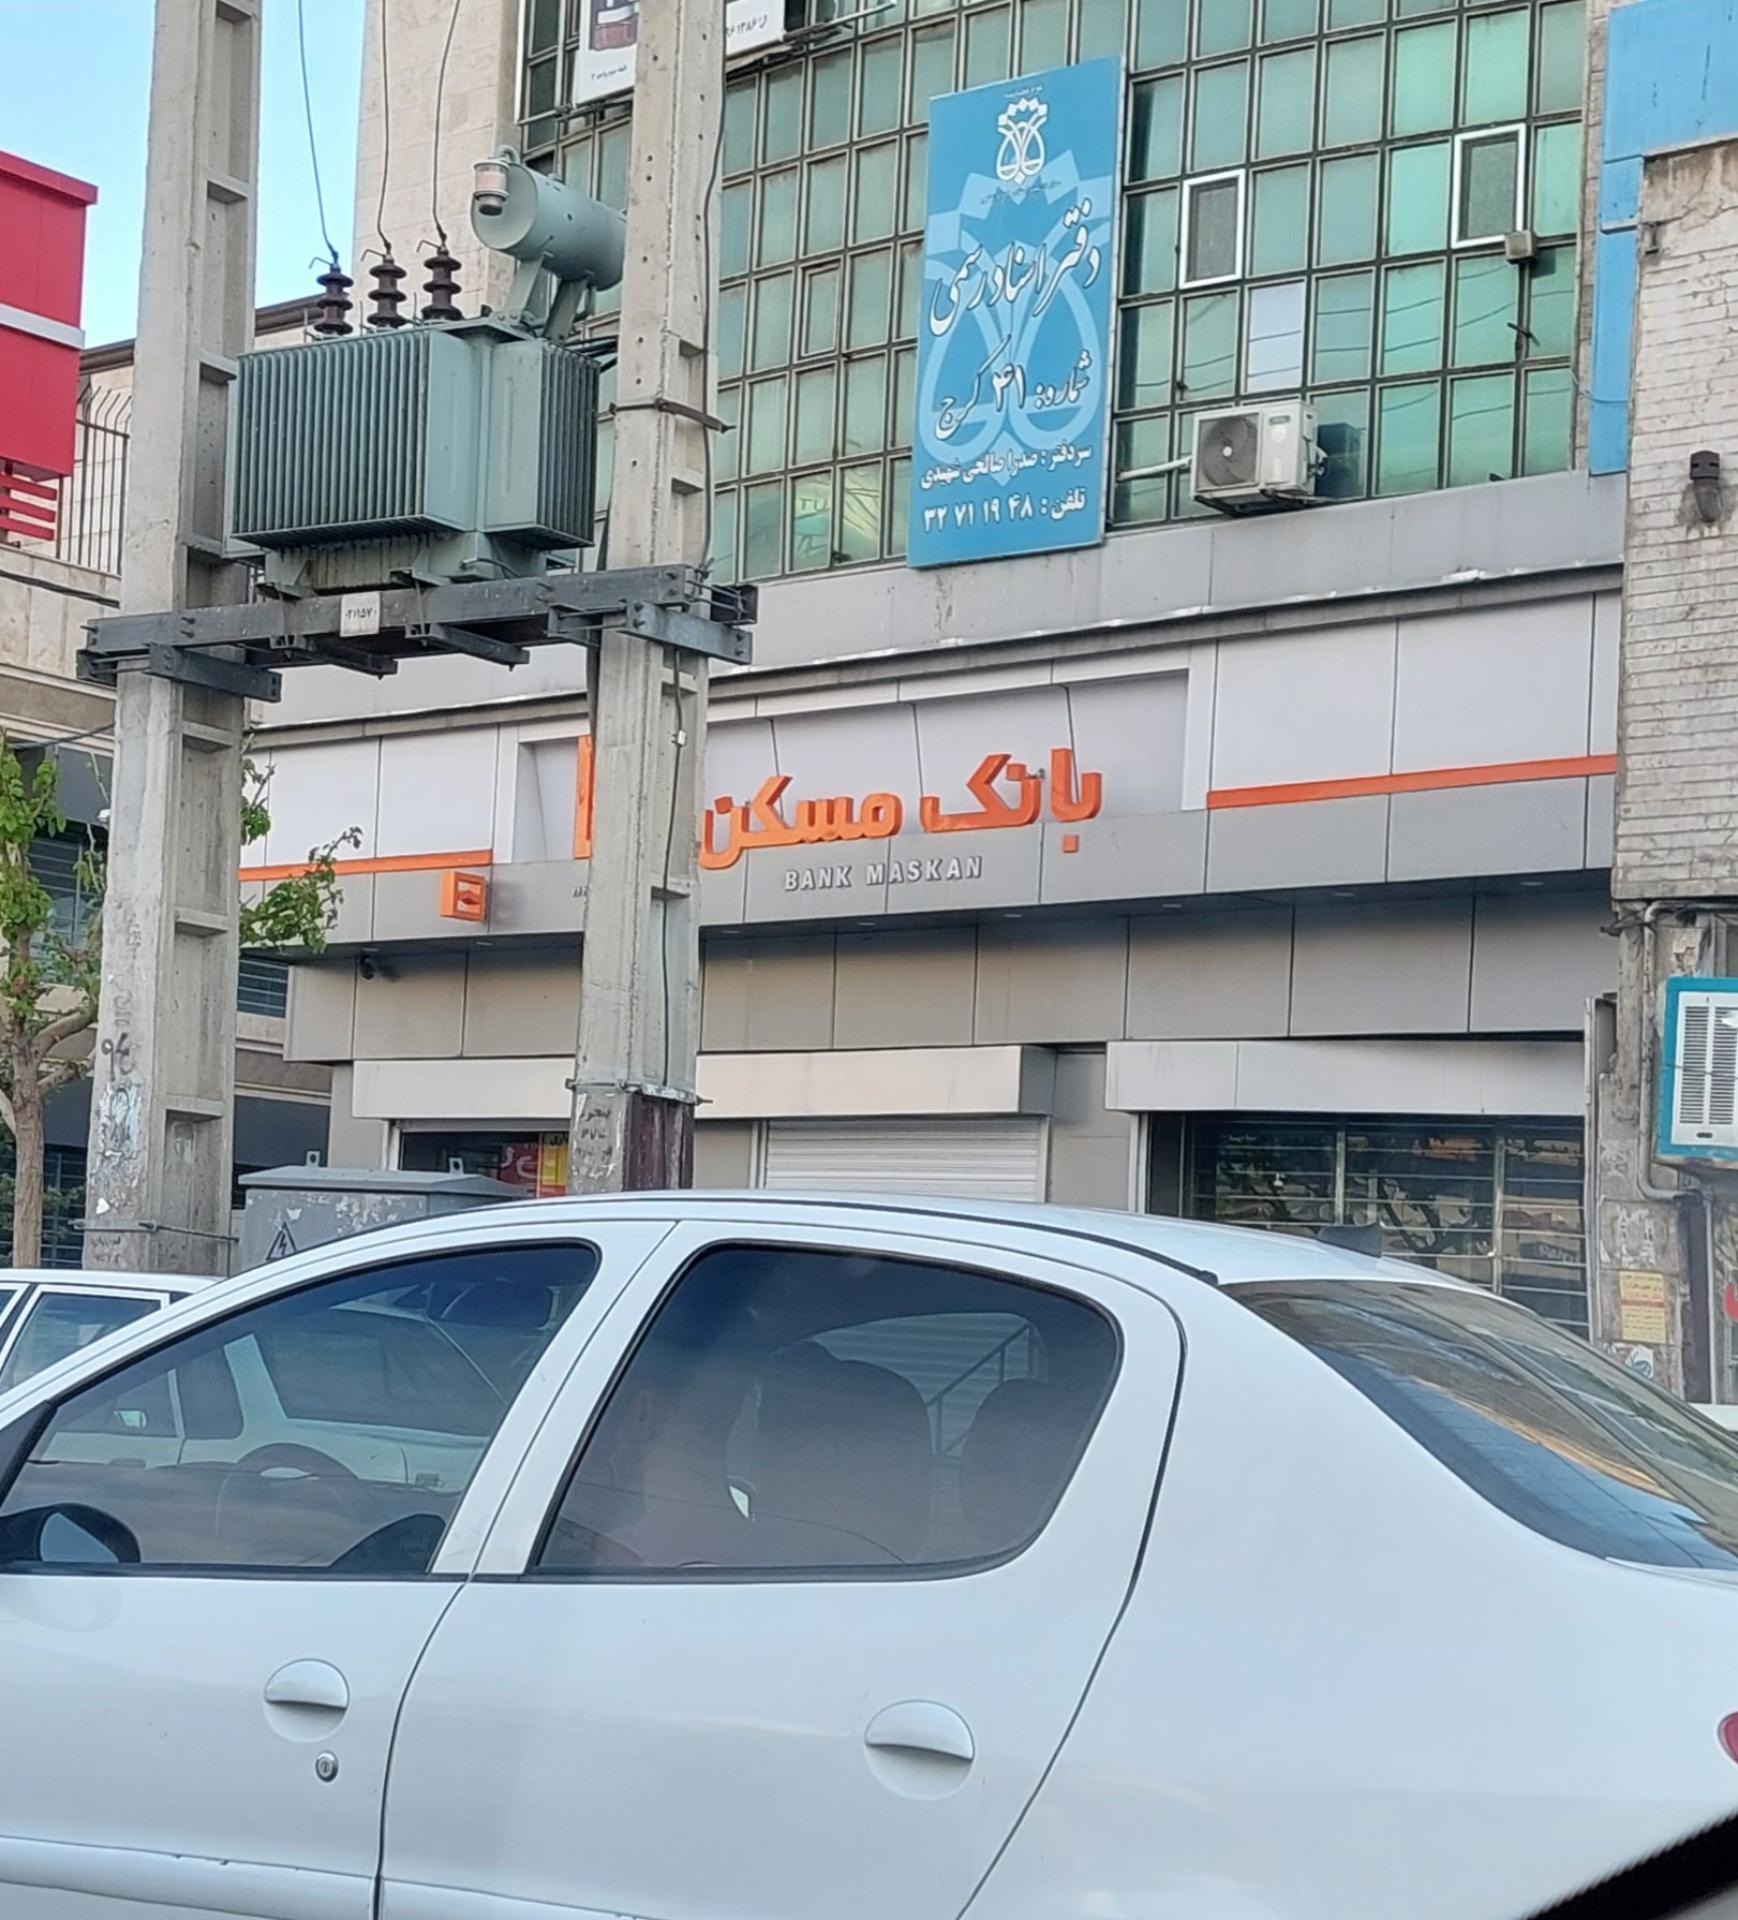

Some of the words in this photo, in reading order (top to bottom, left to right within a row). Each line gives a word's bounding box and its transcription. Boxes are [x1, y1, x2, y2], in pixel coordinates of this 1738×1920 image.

[929, 243, 988, 337] رسمی
[986, 241, 1047, 307] اسناد
[1032, 197, 1101, 317] دفتر
[934, 333, 1012, 441] کرج
[992, 363, 1026, 412] ۴۱
[700, 775, 903, 869] مسکن
[919, 748, 1102, 854] بانک
[784, 865, 852, 892] BANK
[866, 855, 983, 886] MASKAN
